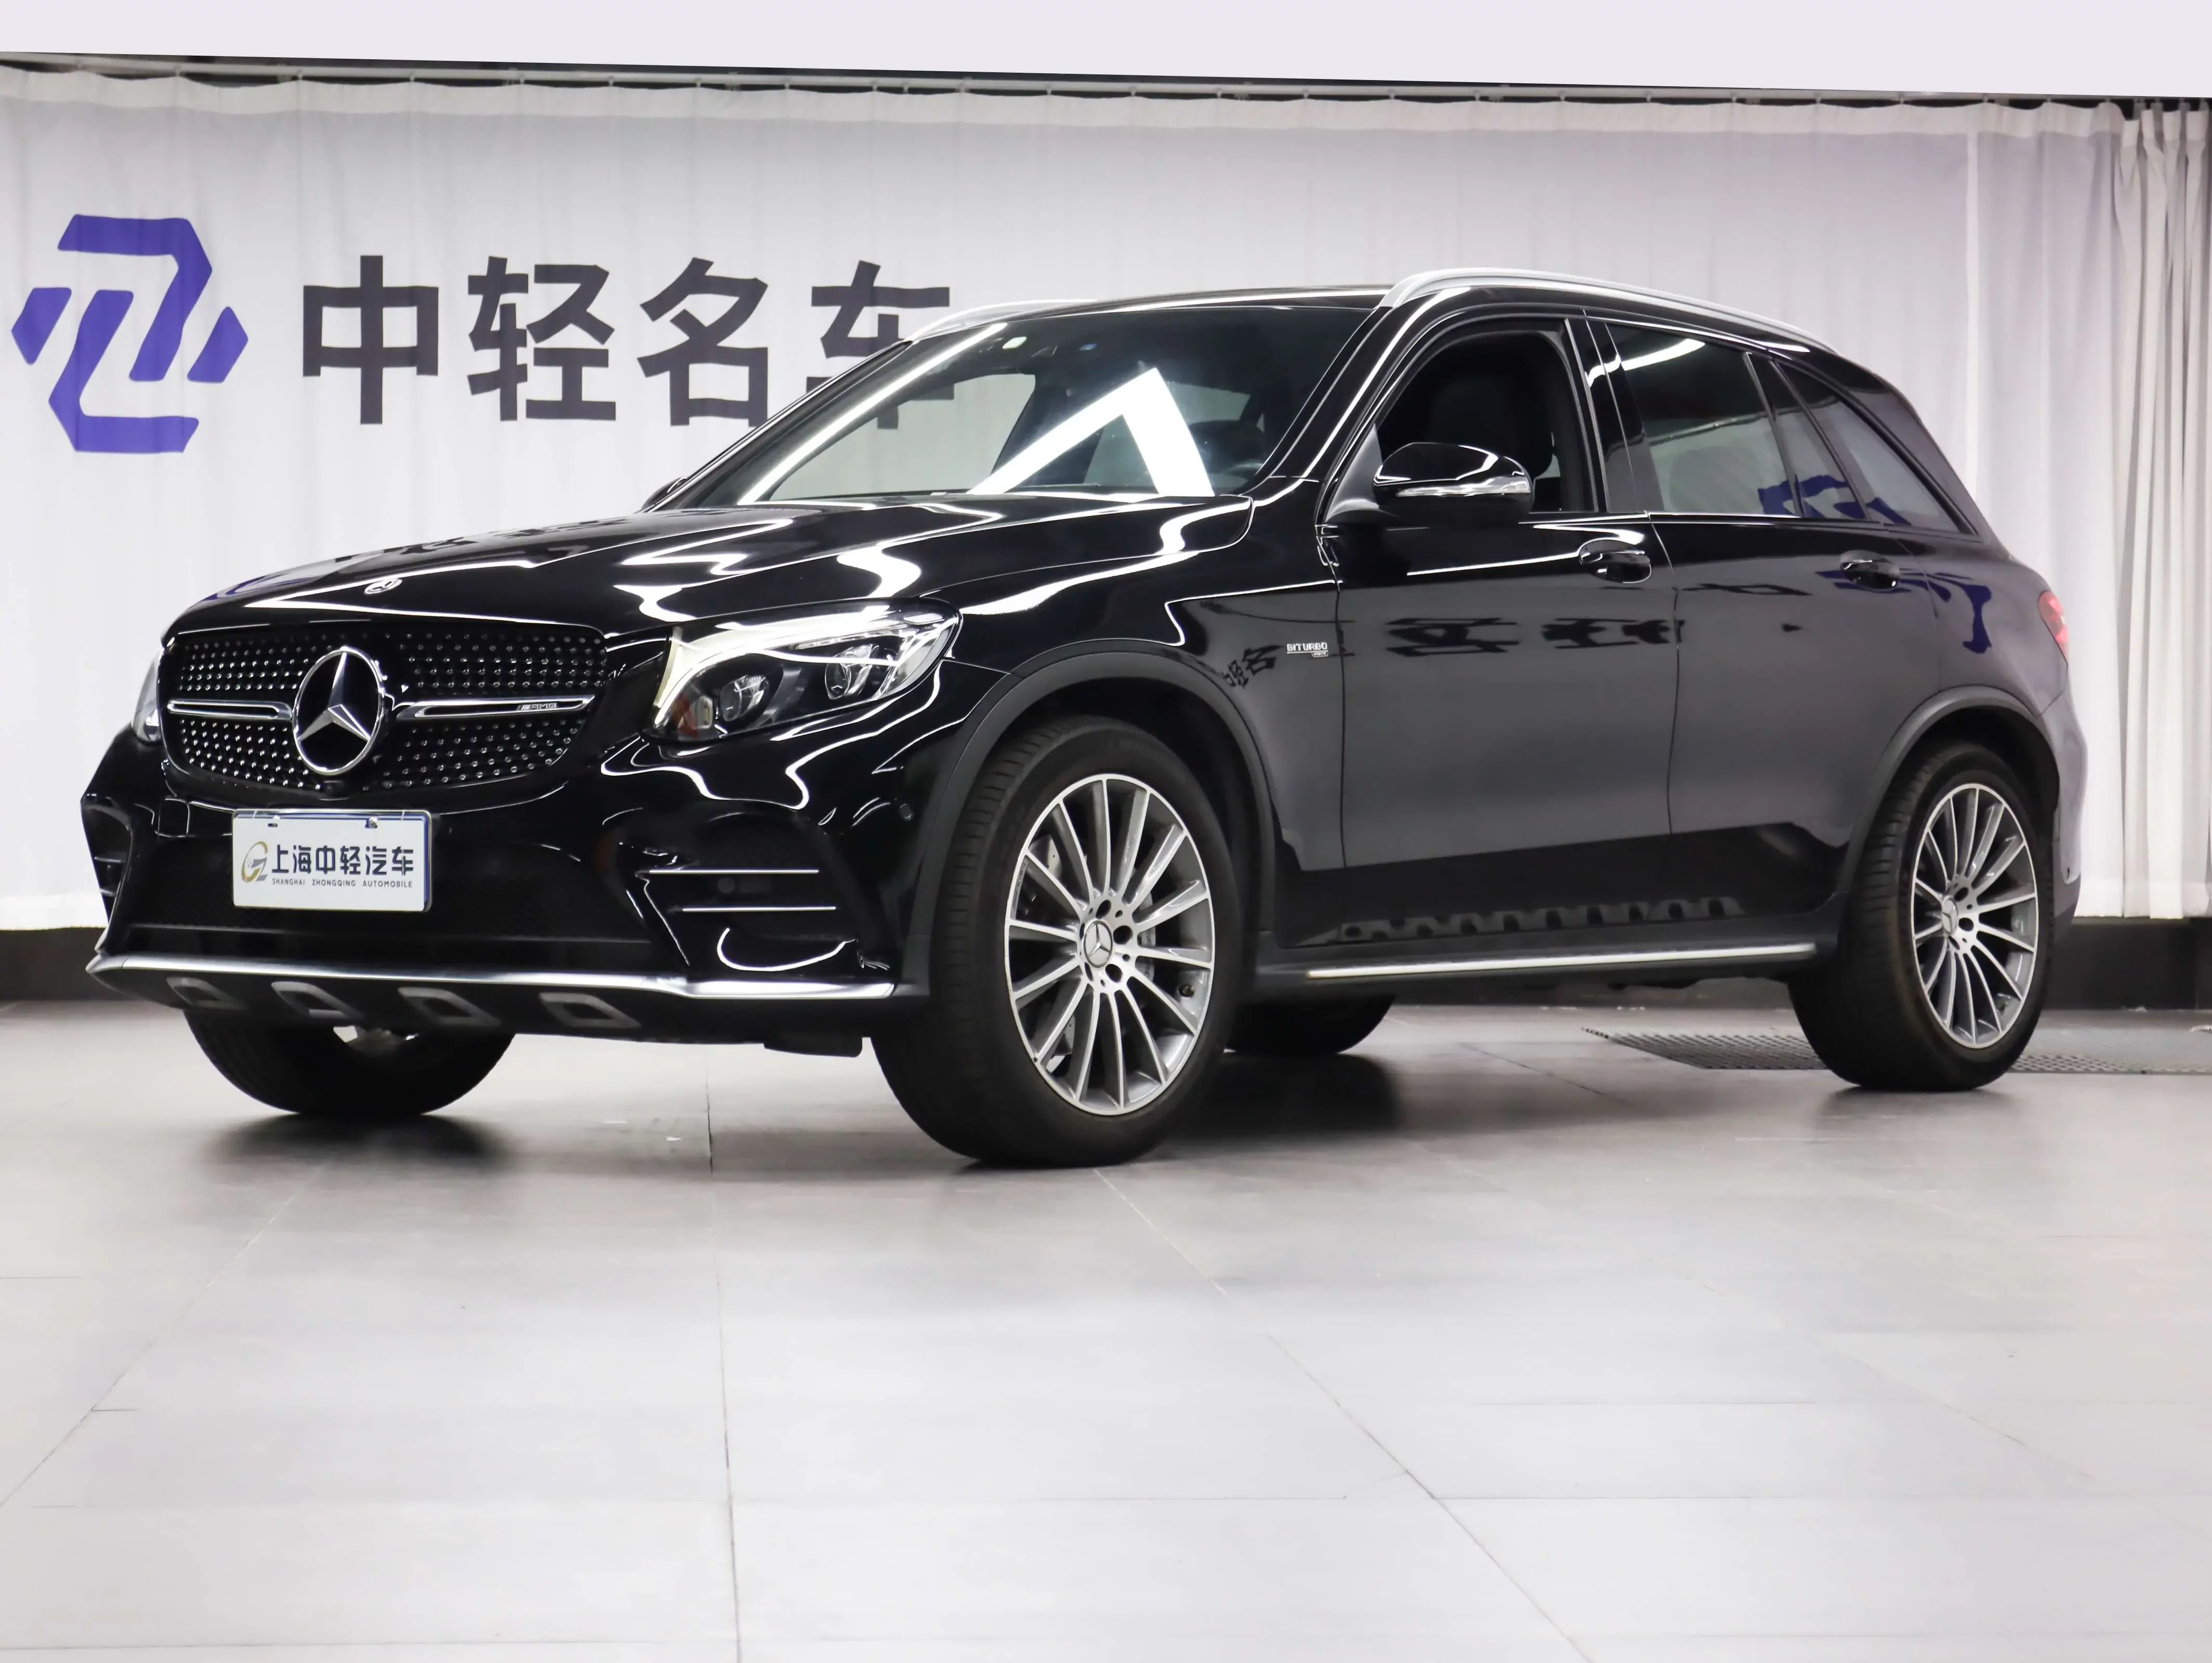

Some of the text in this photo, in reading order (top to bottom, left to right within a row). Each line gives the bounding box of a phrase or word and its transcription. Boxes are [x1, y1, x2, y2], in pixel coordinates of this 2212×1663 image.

[1286, 642, 1328, 652] BITURBO
[271, 844, 414, 876] 上海中轻汽车
[362, 880, 413, 888] AUTOMOBILE
